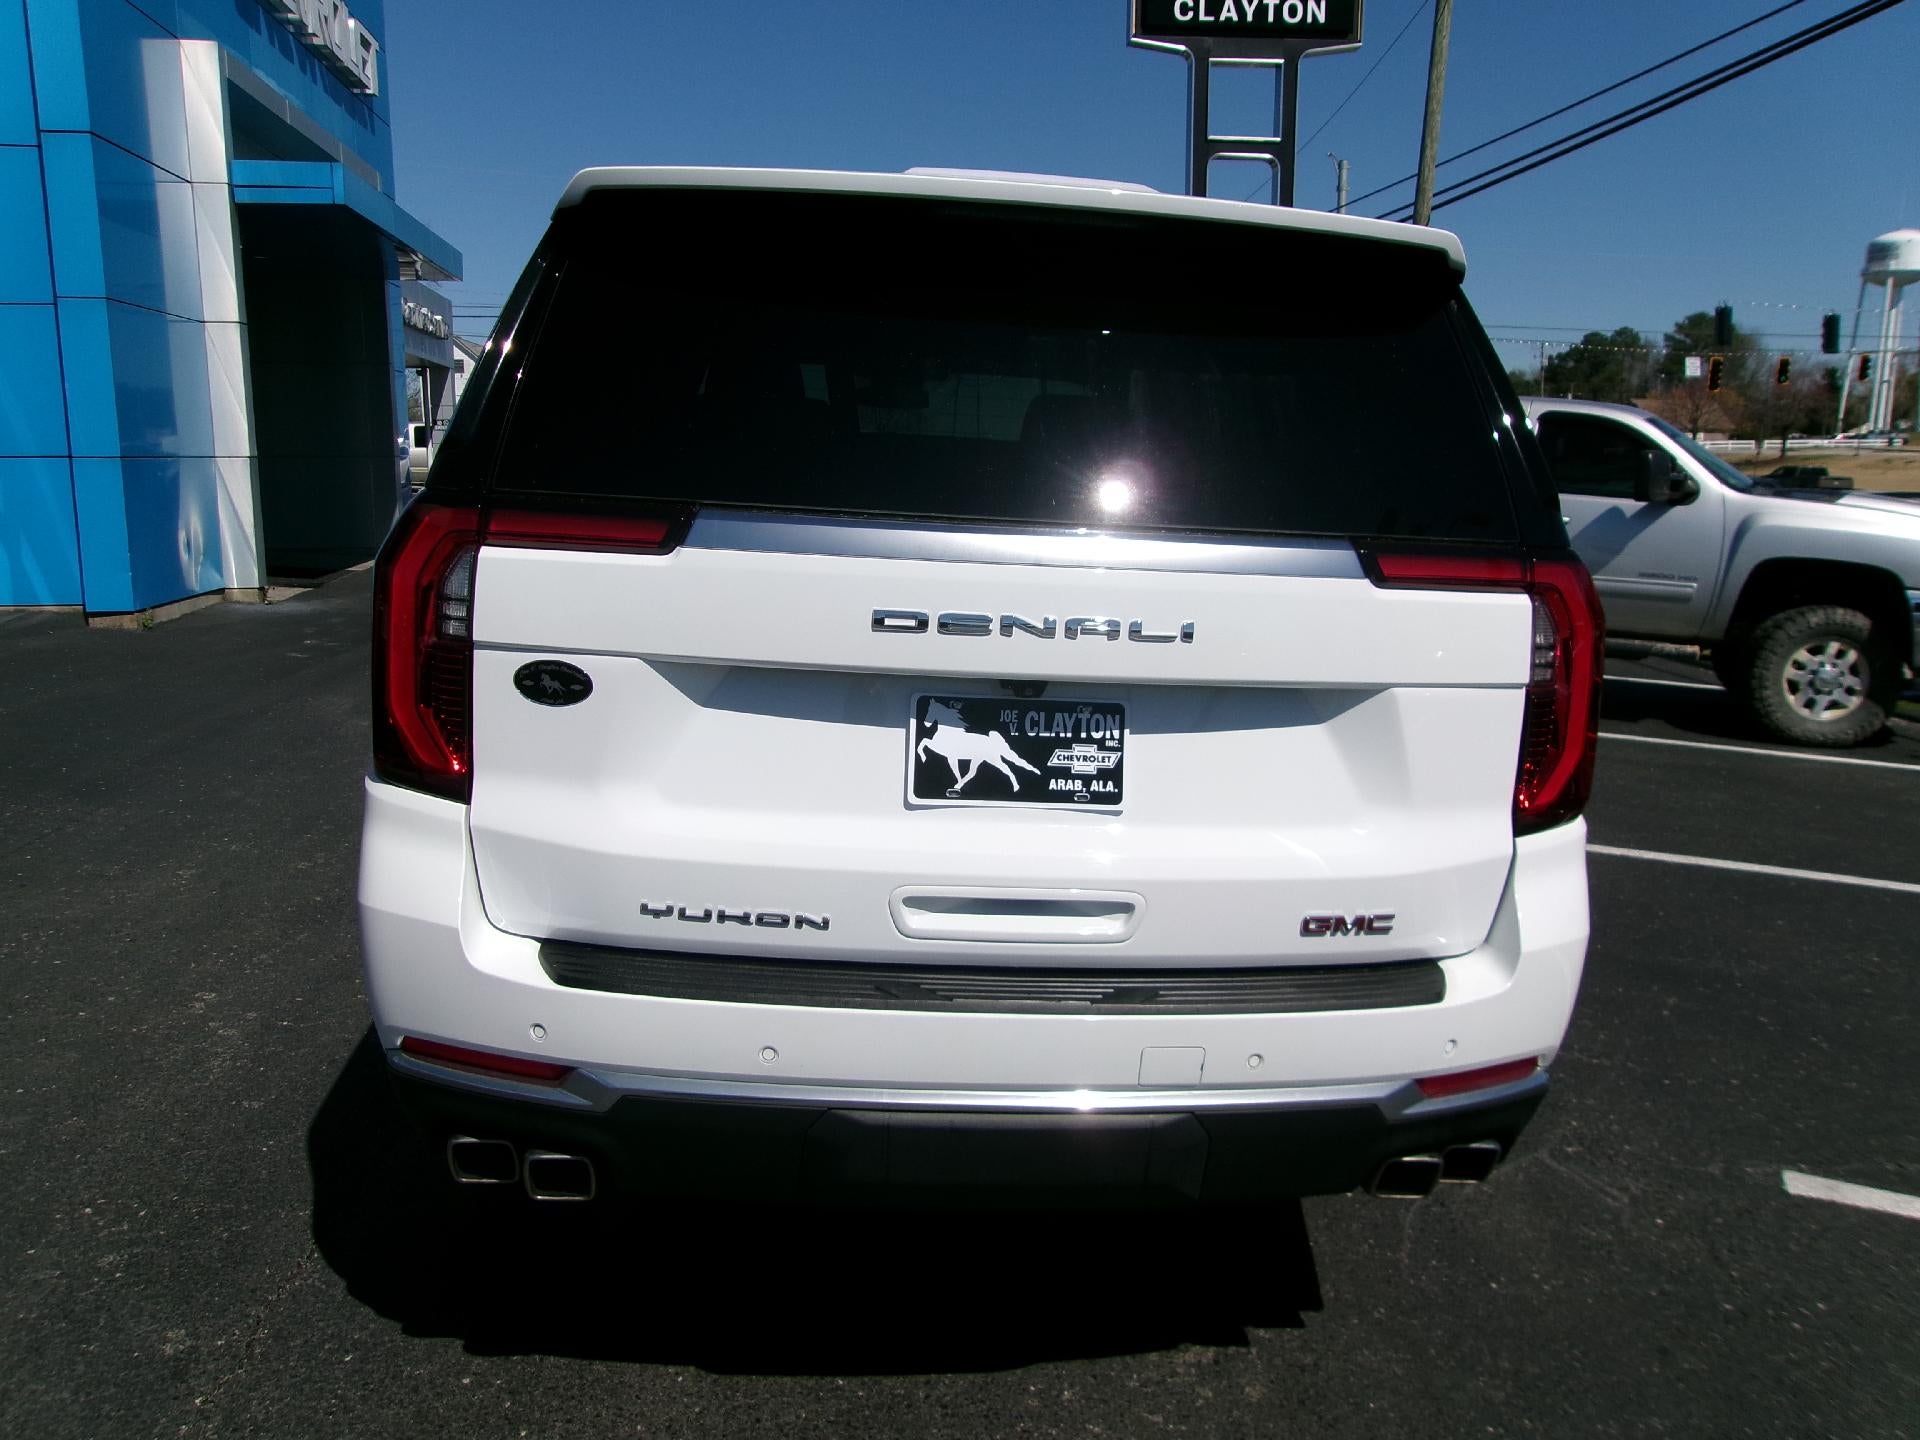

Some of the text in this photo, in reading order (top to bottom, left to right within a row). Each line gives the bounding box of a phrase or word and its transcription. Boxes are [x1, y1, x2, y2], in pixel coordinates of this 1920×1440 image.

[1173, 0, 1327, 24] CLAYTON
[871, 607, 1195, 645] DENALI
[1000, 709, 1020, 722] JOE
[1024, 710, 1120, 739] CLAYTON
[1009, 722, 1019, 736] V.
[1105, 739, 1121, 747] INC.
[1056, 754, 1112, 764] CHEVROLET
[1048, 778, 1119, 793] ARAB, ALA.
[639, 899, 831, 931] YUKON
[1300, 913, 1395, 937] GMC
